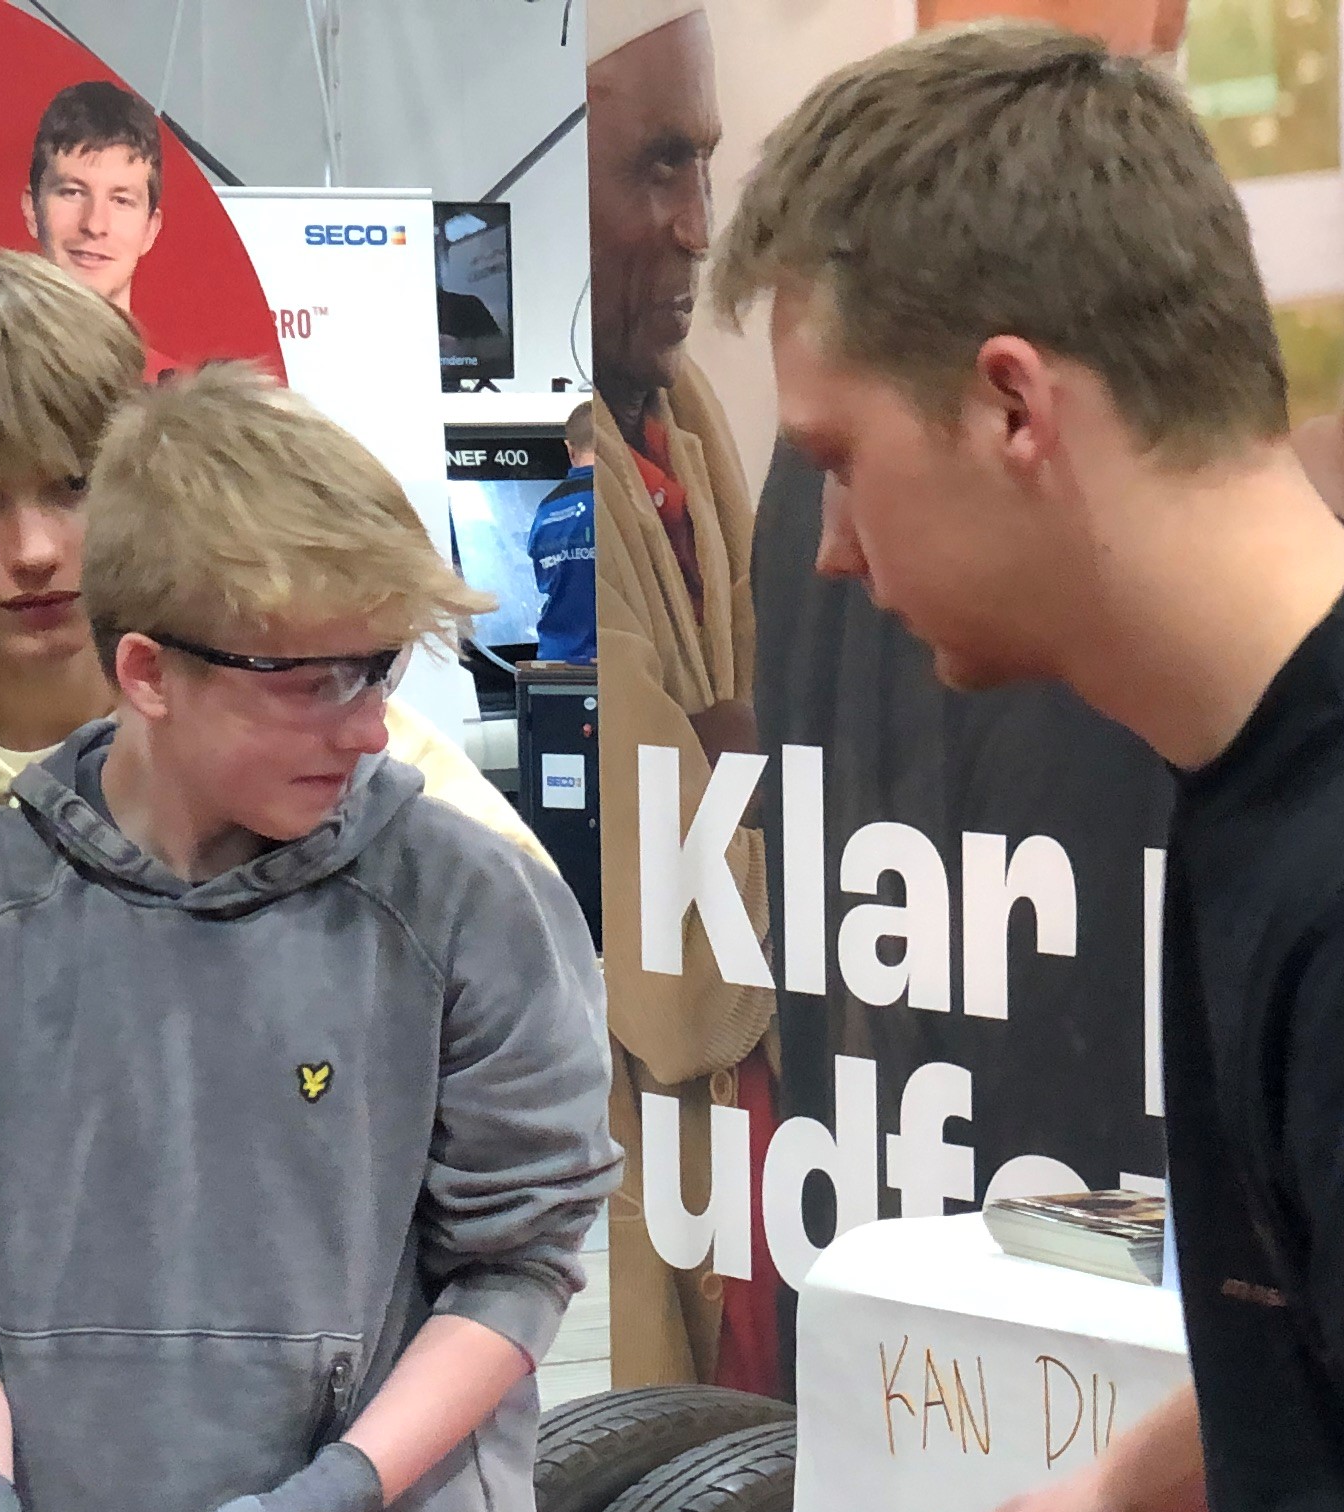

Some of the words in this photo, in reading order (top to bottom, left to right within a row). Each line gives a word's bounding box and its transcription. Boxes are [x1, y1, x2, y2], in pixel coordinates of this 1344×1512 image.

[304, 224, 388, 246] SECO
[445, 449, 487, 467] NEF
[494, 449, 529, 466] 400
[637, 744, 1078, 1020] Klar
[879, 1334, 990, 1455] KAN
